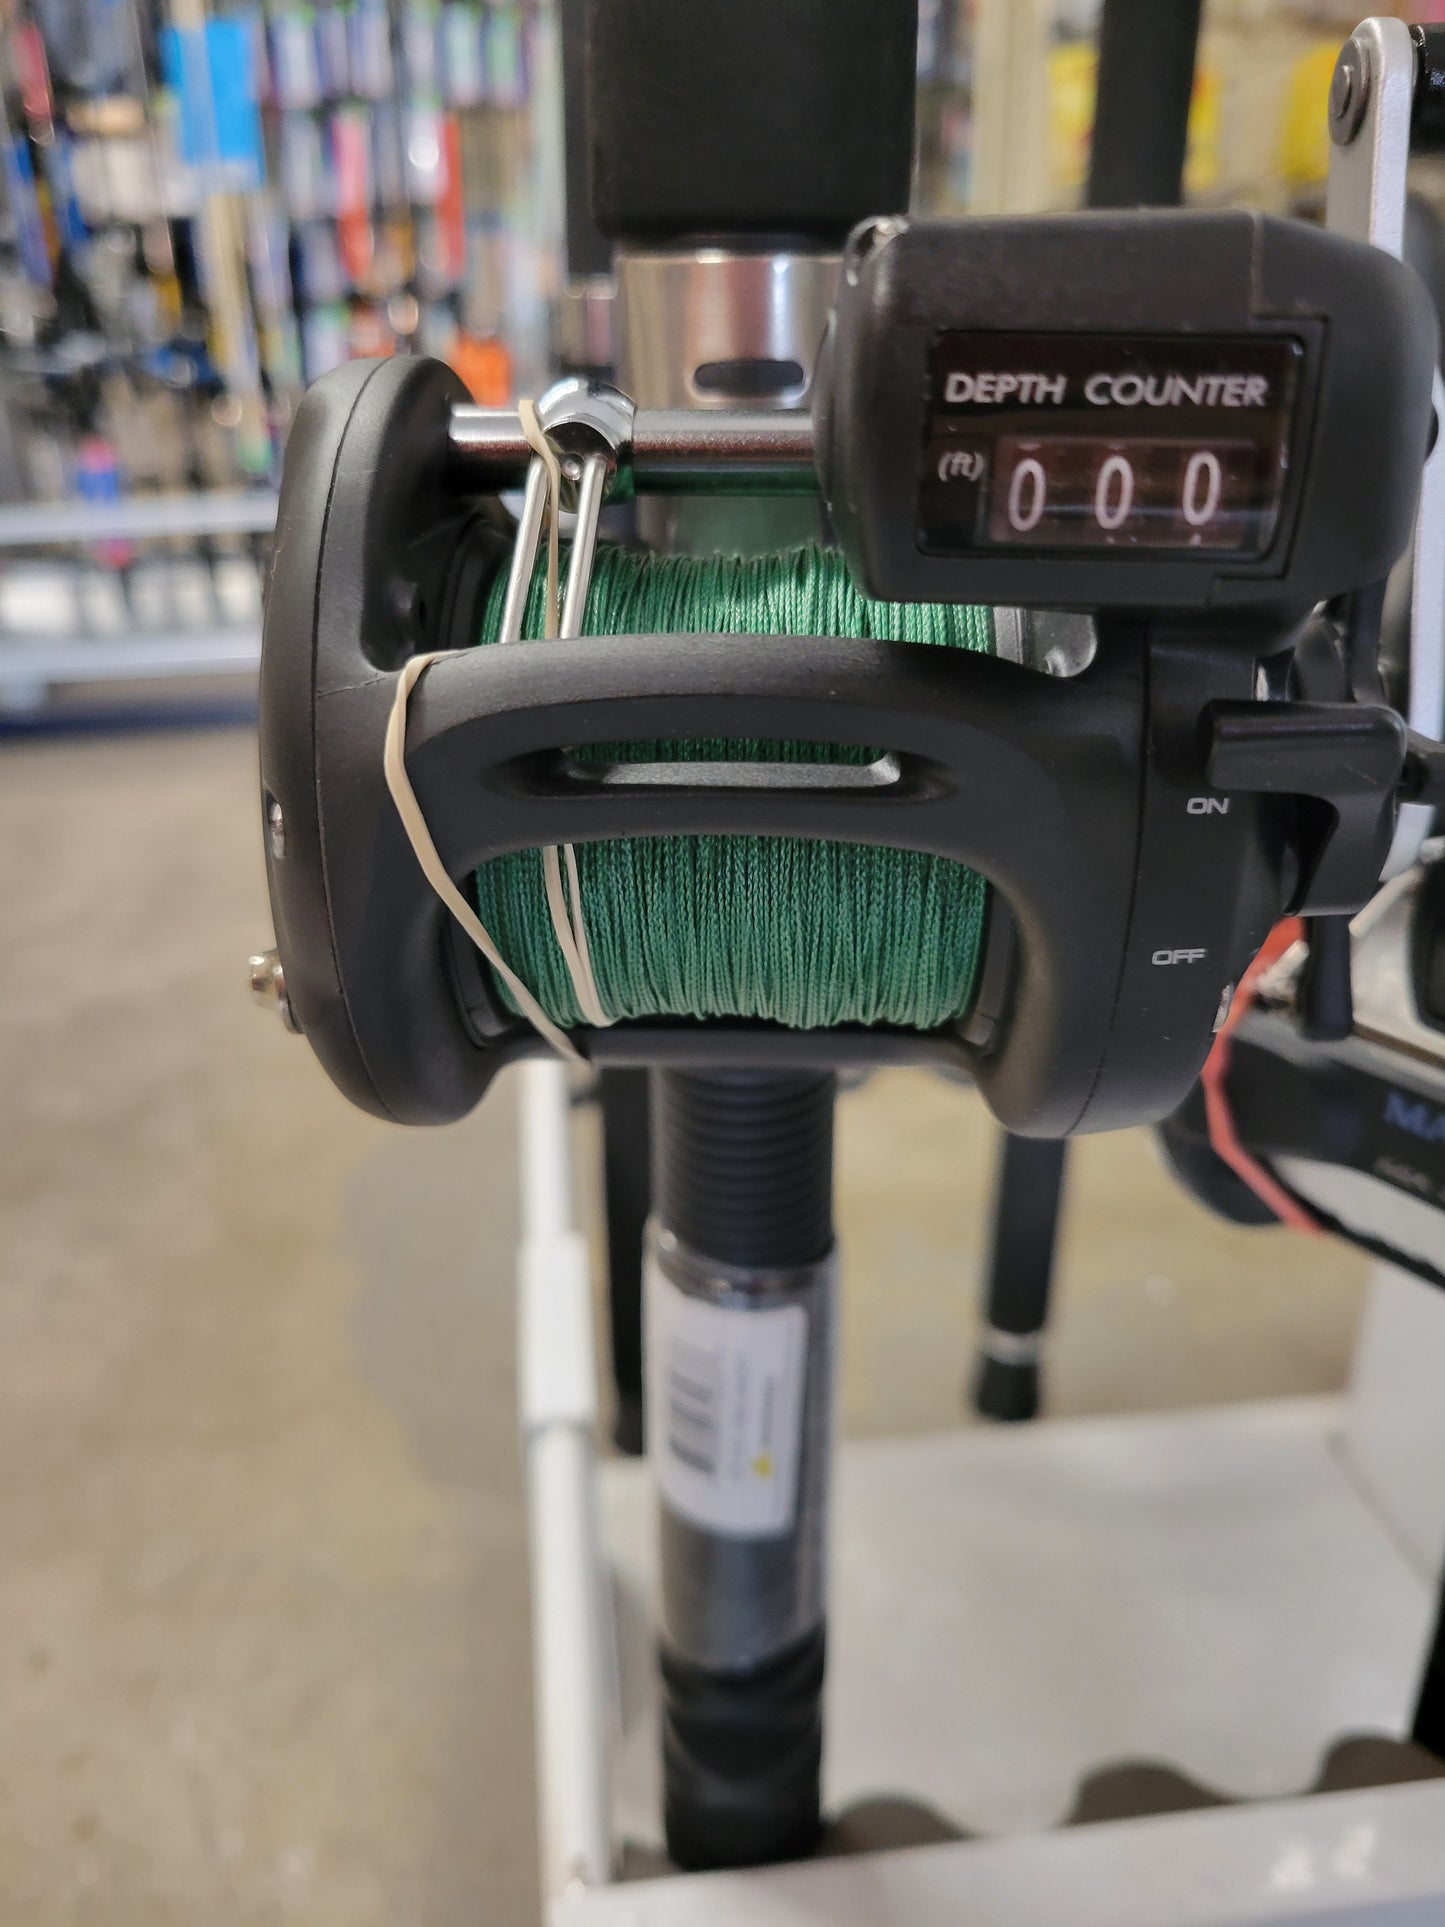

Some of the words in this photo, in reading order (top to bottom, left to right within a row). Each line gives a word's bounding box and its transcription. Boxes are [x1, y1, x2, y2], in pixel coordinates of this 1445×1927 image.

[945, 373, 1066, 404] DEPTH
[1084, 374, 1268, 406] COUNTER
[1187, 797, 1229, 814] ON
[1152, 948, 1206, 966] OFF
